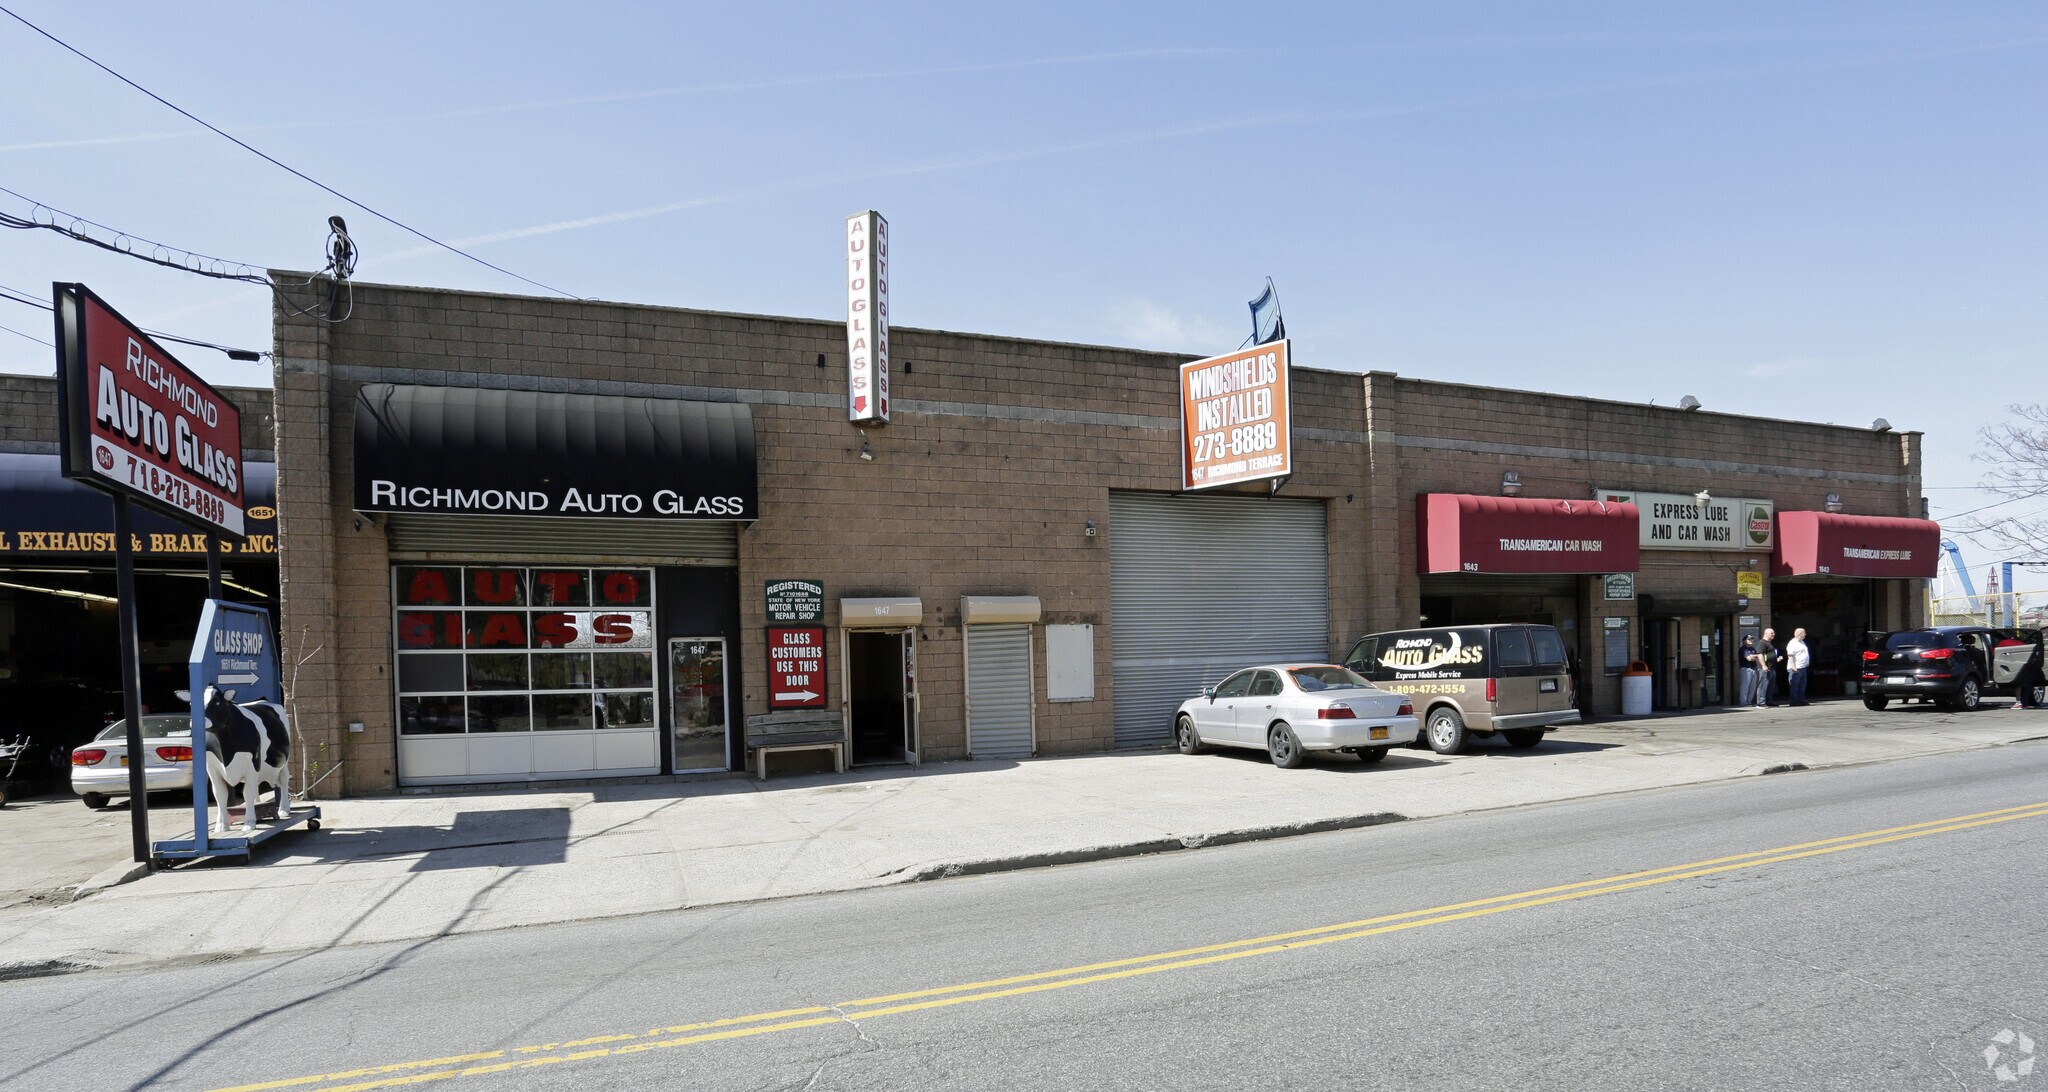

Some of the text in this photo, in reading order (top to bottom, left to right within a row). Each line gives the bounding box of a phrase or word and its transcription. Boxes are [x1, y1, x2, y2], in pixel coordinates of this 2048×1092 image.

[126, 337, 217, 428] RICHMOND
[1188, 351, 1277, 401] WINDSHIELDS
[1197, 387, 1272, 432] INSTALLED
[97, 364, 238, 496] AUTO GLASS
[1193, 421, 1277, 463] 273-8889
[1191, 453, 1283, 481] 1647 RICHMOND TERRACE
[126, 455, 225, 525] 718-273-8889
[371, 479, 744, 515] RICHMOND AUTO GLASS
[250, 508, 275, 518] 1651
[1654, 503, 1728, 522] EXPRESS LUBE
[1651, 524, 1731, 542] AND CAR WASH
[18, 532, 116, 551] EXHAUST
[150, 534, 233, 553] BRAKS
[1500, 538, 1602, 552] TRANSAMERICAN CAR WASH
[1843, 547, 1880, 559] TRANSAMERICAN
[1880, 550, 1900, 560] EXPRESS
[1463, 562, 1478, 572] 1643
[411, 572, 639, 603] AUTO
[766, 581, 822, 595] REGISTERED
[768, 603, 821, 612] MOTOR VEHICLE
[874, 606, 890, 615] 1647
[775, 612, 815, 620] REPAIR SHOP
[401, 614, 634, 646] GLASS
[213, 629, 263, 656] GLASS SHOP
[783, 633, 810, 644] GLASS
[1395, 638, 1433, 649] RICHMOND
[690, 645, 706, 655] 1647
[772, 647, 822, 659] CUSTOMERS
[1382, 643, 1483, 667] AUTO GLASS
[231, 658, 250, 670] Richmond
[776, 660, 818, 672] USE THIS
[786, 675, 809, 686] DOOR
[1395, 670, 1462, 680] Express Mobile Service
